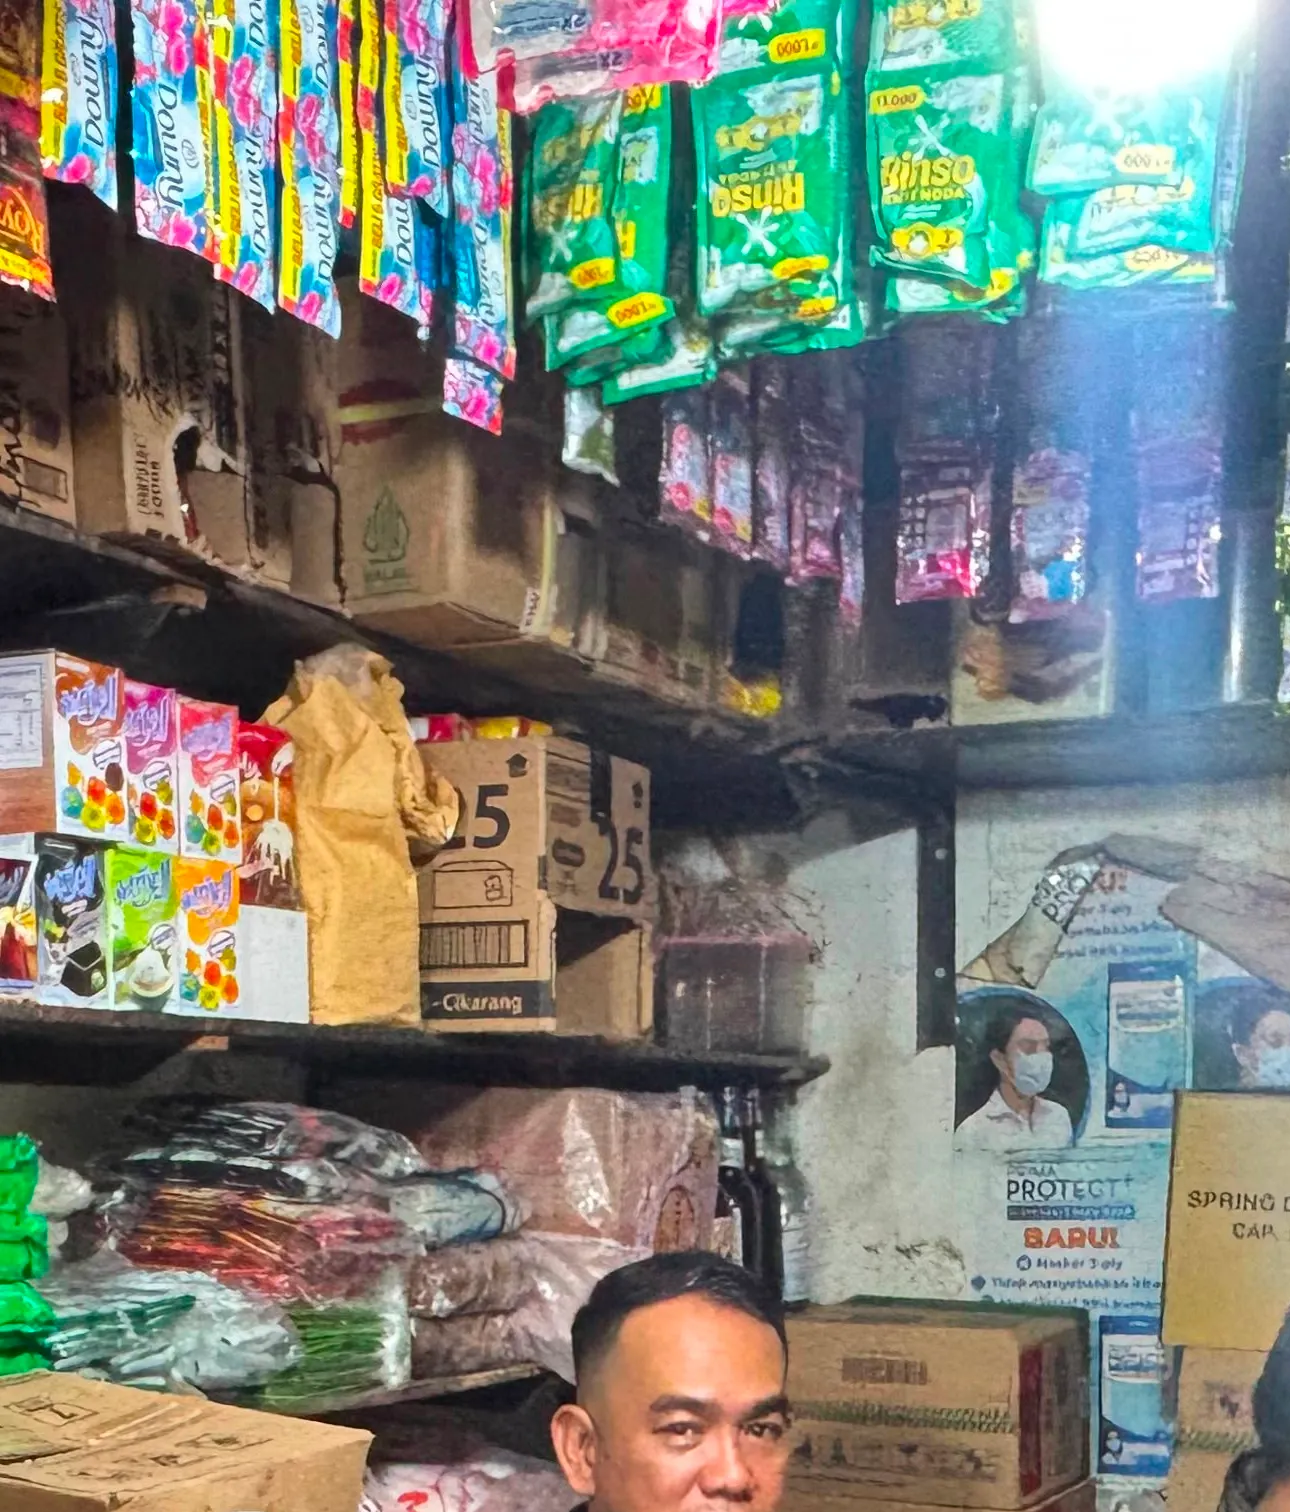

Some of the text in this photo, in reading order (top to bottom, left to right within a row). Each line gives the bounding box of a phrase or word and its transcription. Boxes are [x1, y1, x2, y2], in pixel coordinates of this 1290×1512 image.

[78, 16, 107, 148] Downy
[416, 55, 441, 169] Downy
[153, 82, 186, 209] Downy
[881, 151, 976, 194] Rinso
[246, 130, 268, 254] Downy
[313, 170, 336, 281] Downy
[712, 172, 805, 218] Rinso
[395, 197, 413, 268] Dow
[442, 992, 523, 1015] Cikarang
[1186, 1189, 1276, 1213] SPRING
[1023, 1227, 1121, 1249] BARU!
